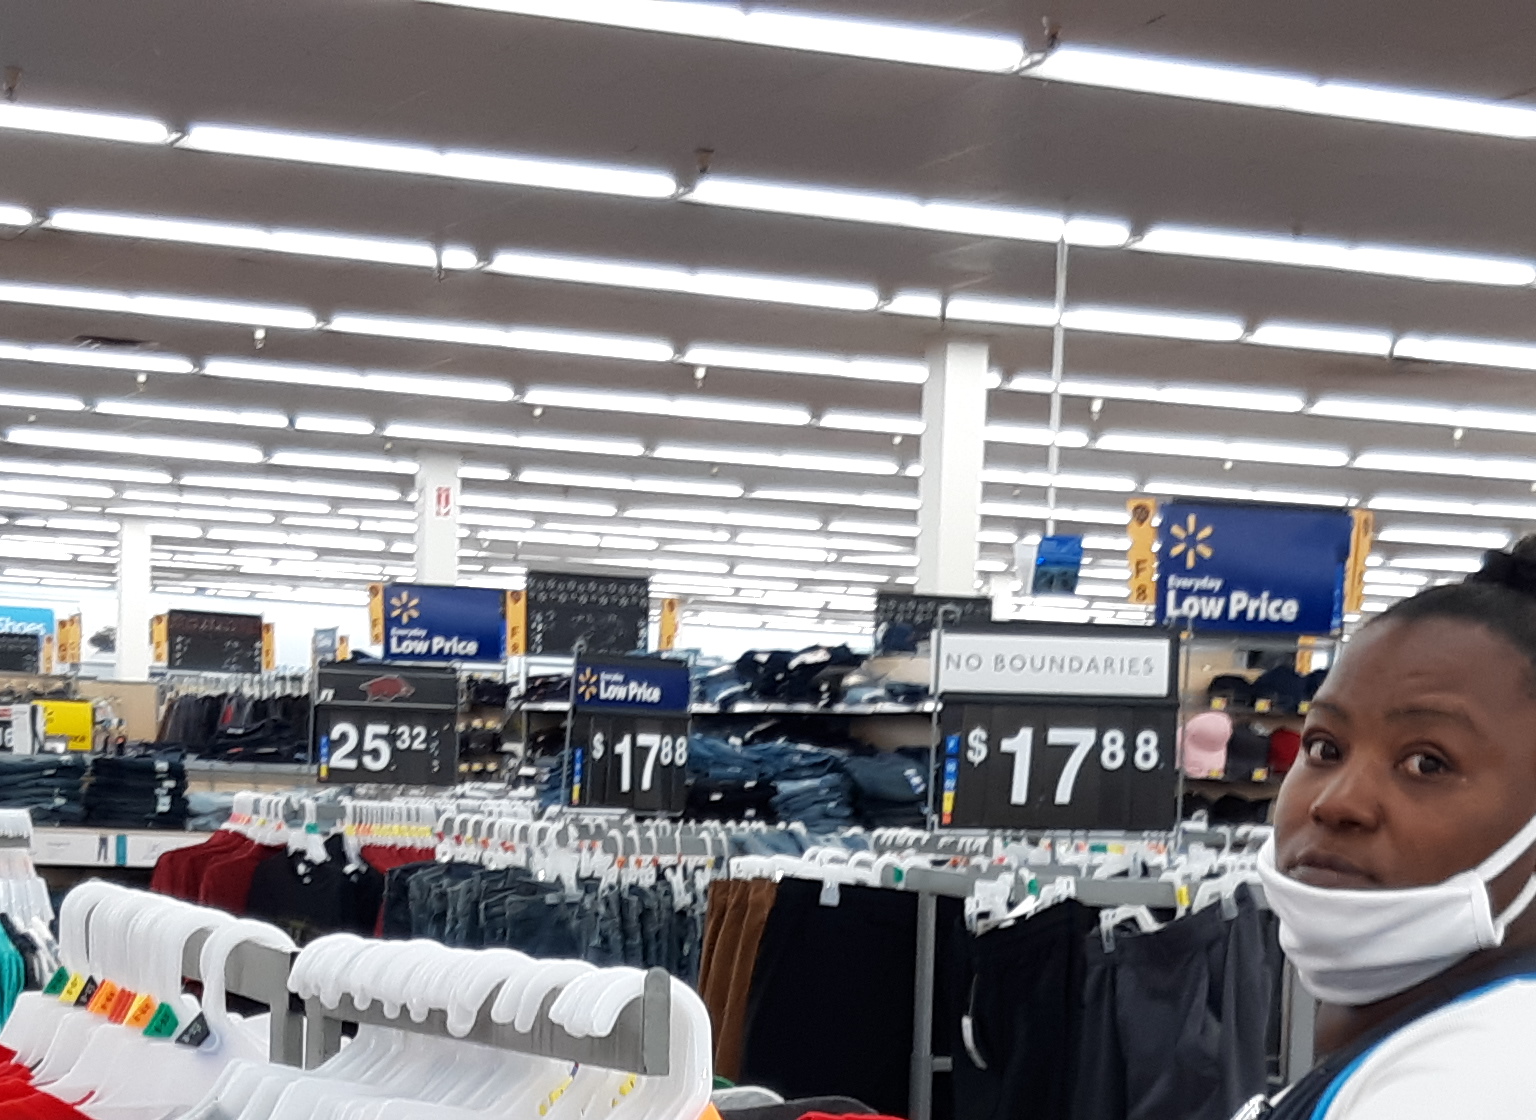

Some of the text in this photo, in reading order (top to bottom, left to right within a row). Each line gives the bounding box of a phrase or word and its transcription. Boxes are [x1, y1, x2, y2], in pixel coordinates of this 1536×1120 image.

[1166, 575, 1224, 592] Everyday
[1166, 589, 1300, 622] Low Price
[390, 636, 430, 655] Low
[431, 635, 479, 656] Price
[945, 653, 1155, 676] NO BOUNDARIES
[600, 678, 662, 704] Low Price
